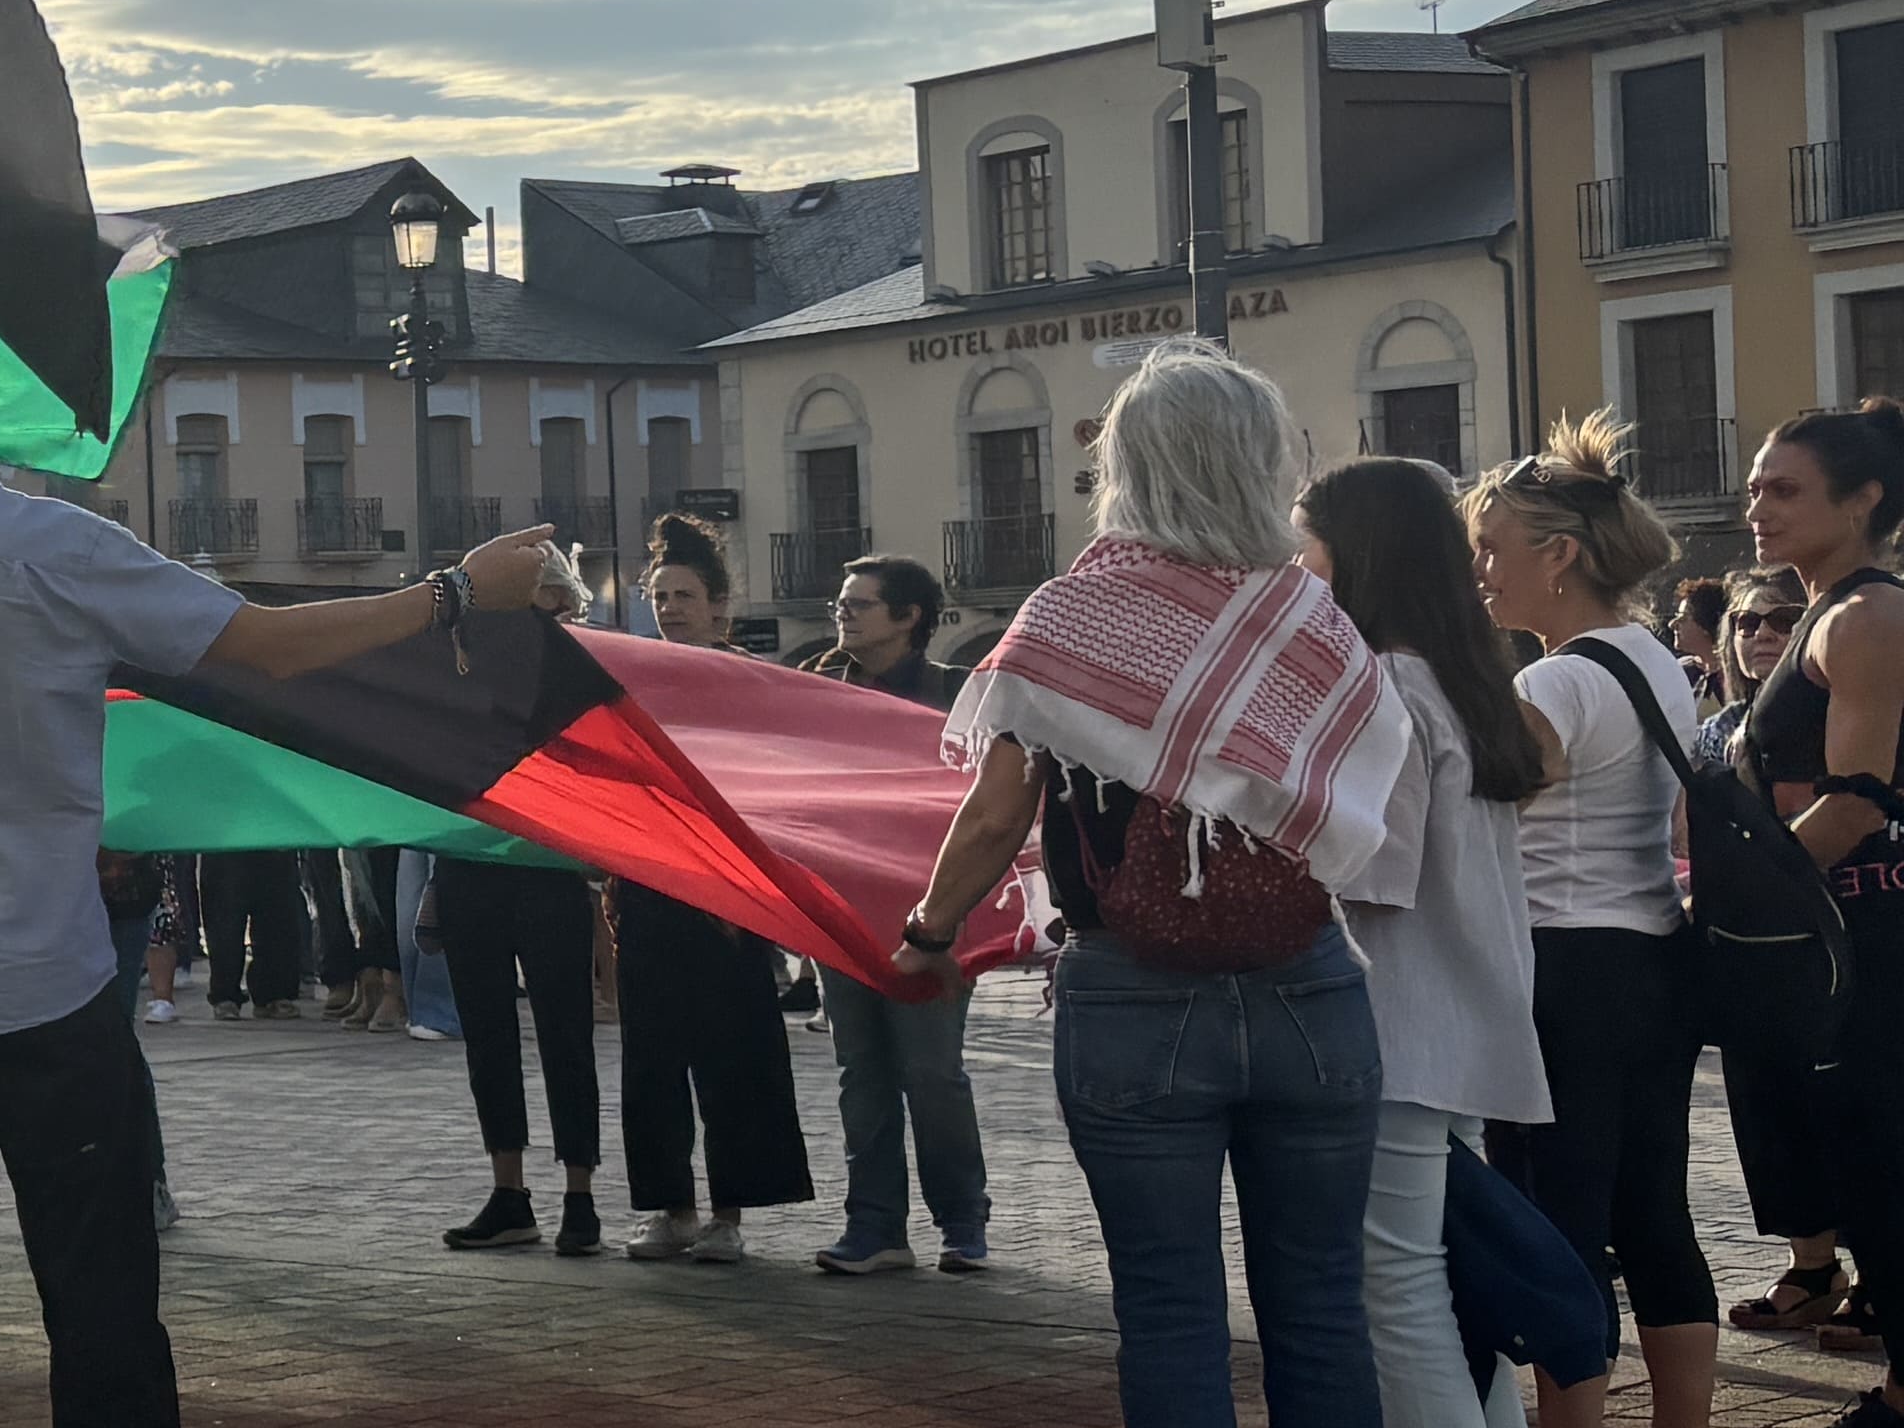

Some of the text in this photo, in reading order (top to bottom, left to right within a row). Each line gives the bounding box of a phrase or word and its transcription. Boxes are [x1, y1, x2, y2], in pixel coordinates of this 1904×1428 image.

[908, 288, 1289, 364] HOTEL AROI BIERZO AZA
